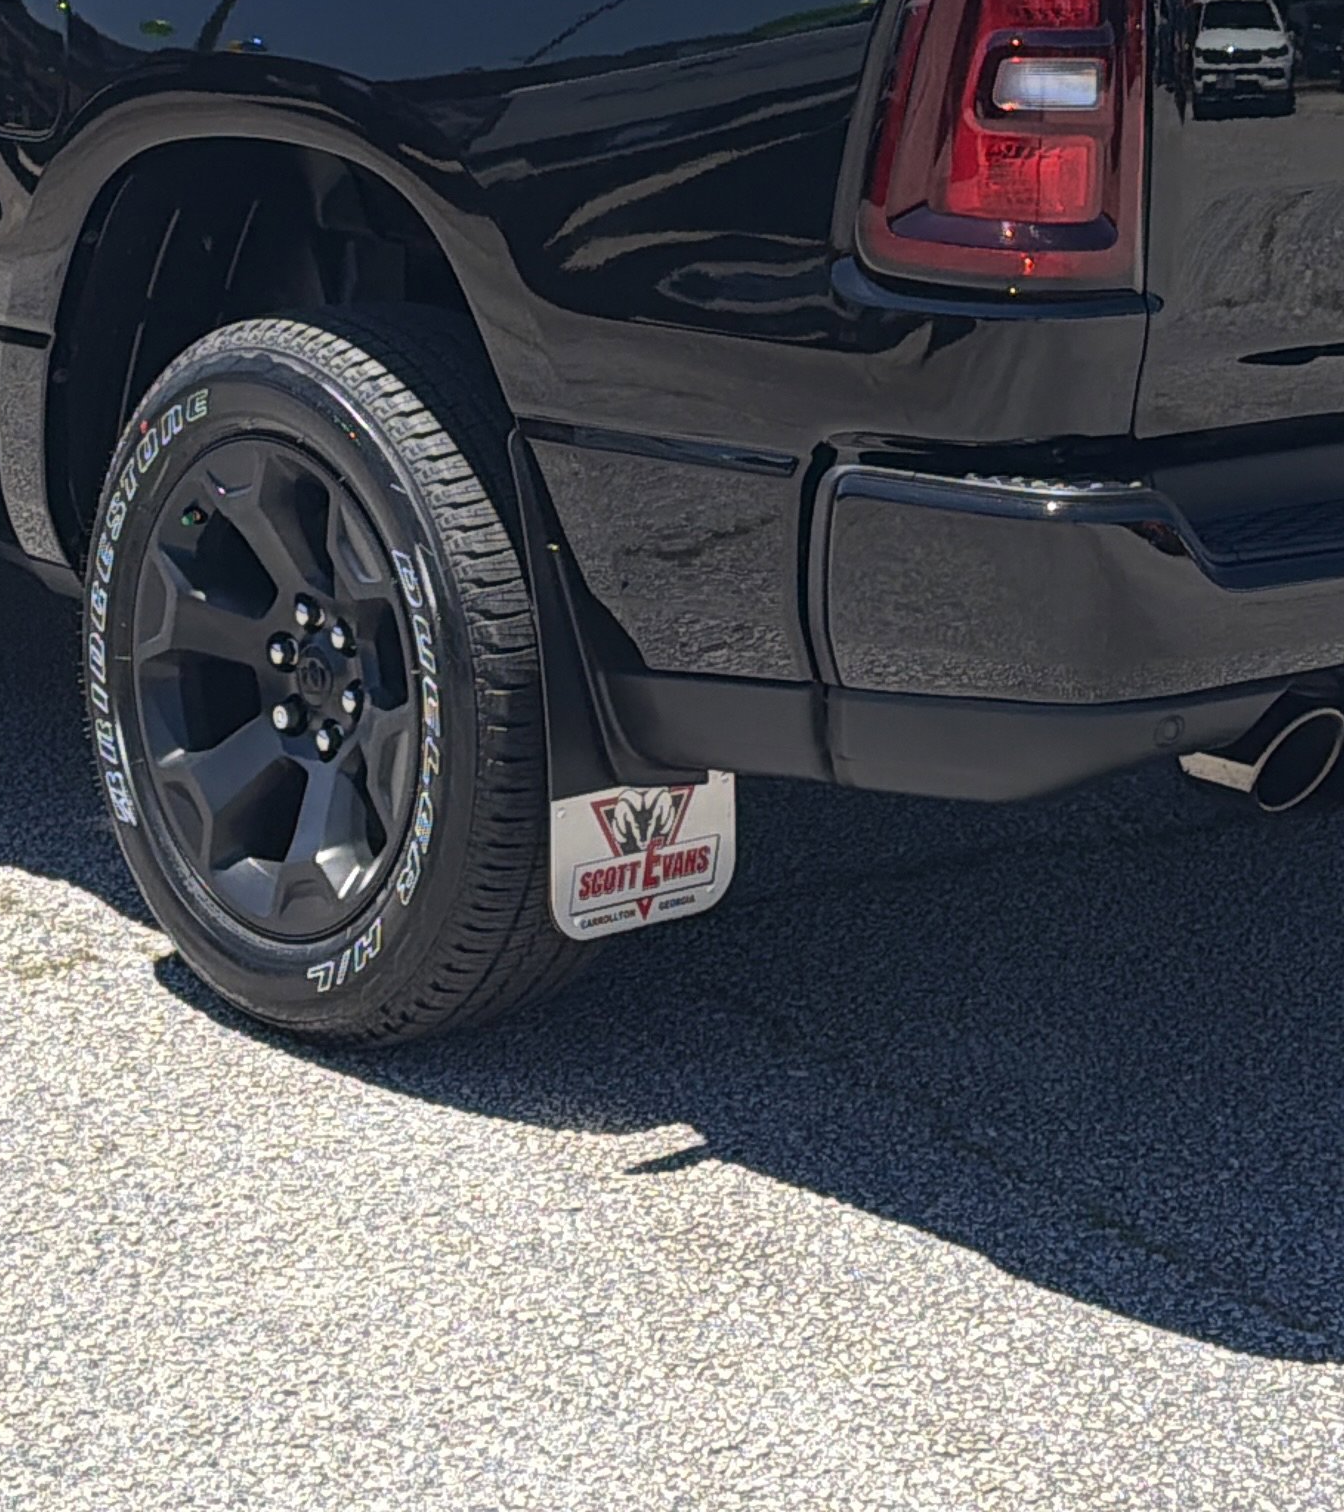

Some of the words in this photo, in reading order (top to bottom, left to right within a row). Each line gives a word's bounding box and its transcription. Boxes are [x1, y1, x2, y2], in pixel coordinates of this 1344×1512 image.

[89, 388, 209, 827] BRIDGESTONE
[392, 549, 442, 906] DUELER
[578, 859, 642, 901] SCOTT
[642, 837, 712, 892] EVANS
[580, 909, 637, 930] CARROLLTON
[658, 894, 696, 911] GEORGIA
[307, 917, 383, 992] H/L
